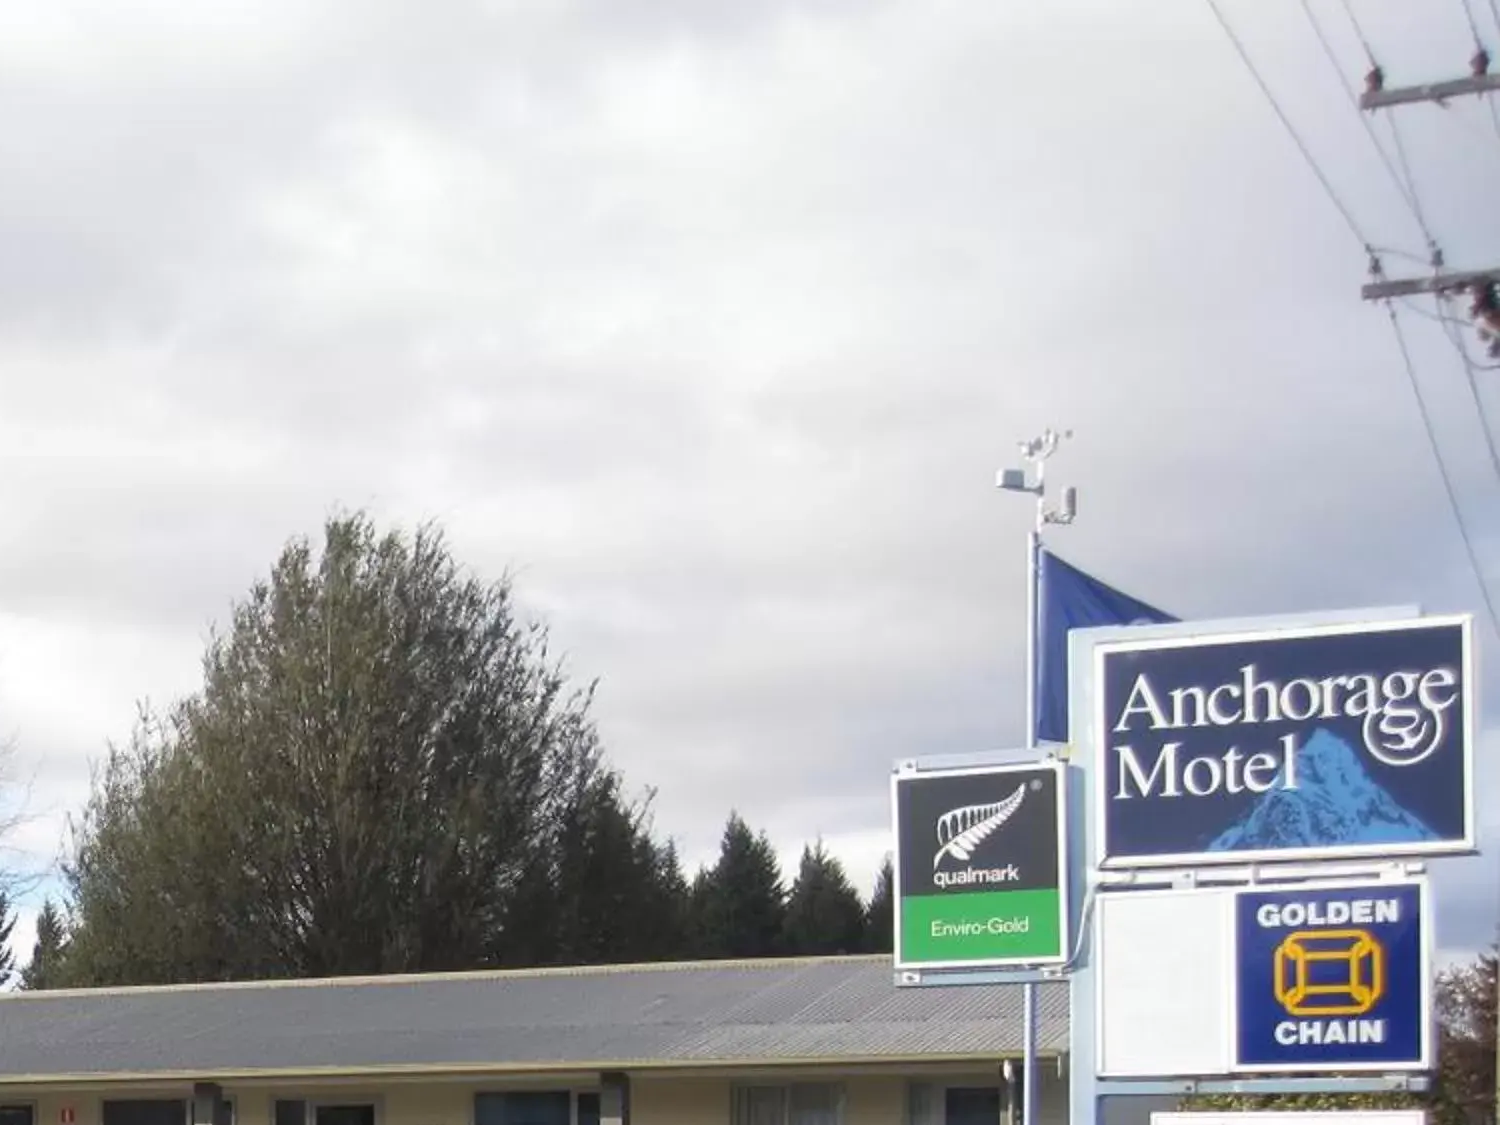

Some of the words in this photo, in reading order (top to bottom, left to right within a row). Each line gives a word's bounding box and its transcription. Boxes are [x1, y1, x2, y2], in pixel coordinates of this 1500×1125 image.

[1112, 665, 1457, 765] Anchorage
[1113, 734, 1299, 800] Motel
[933, 864, 1020, 888] qualmark
[931, 916, 1029, 937] Enviro-Gold
[1257, 900, 1399, 928] GOLDEN
[1274, 1019, 1384, 1046] CHAIN
